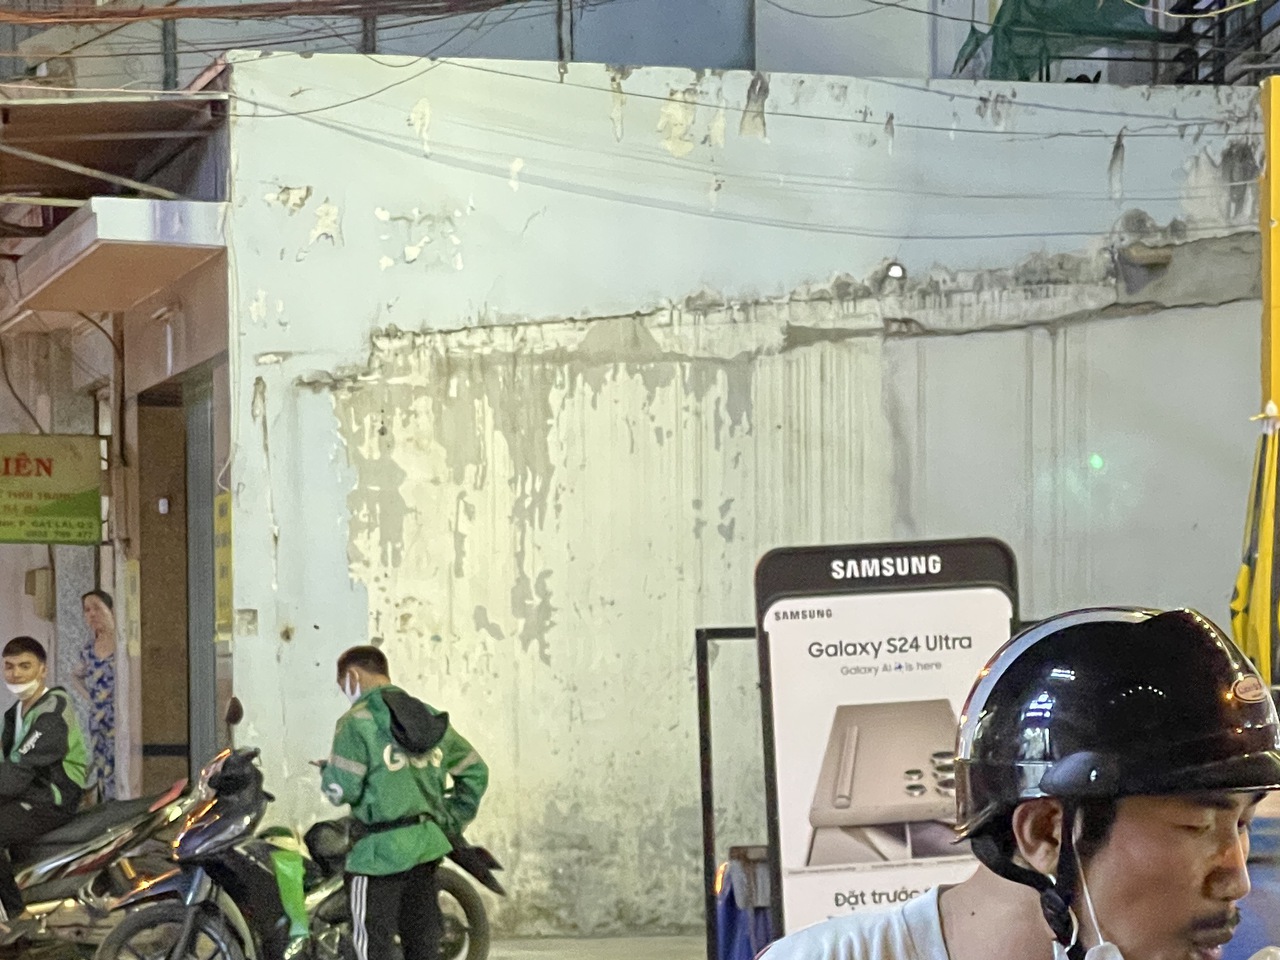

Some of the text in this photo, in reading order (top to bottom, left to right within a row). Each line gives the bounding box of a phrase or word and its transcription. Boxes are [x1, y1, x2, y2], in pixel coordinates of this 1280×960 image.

[831, 555, 942, 580] SAMSUNG
[774, 608, 833, 622] SAMSUNG
[808, 633, 973, 661] Galaxy S24 Ultra
[840, 664, 880, 677] Galaxy
[916, 661, 942, 672] here
[835, 891, 866, 911] Đặt
